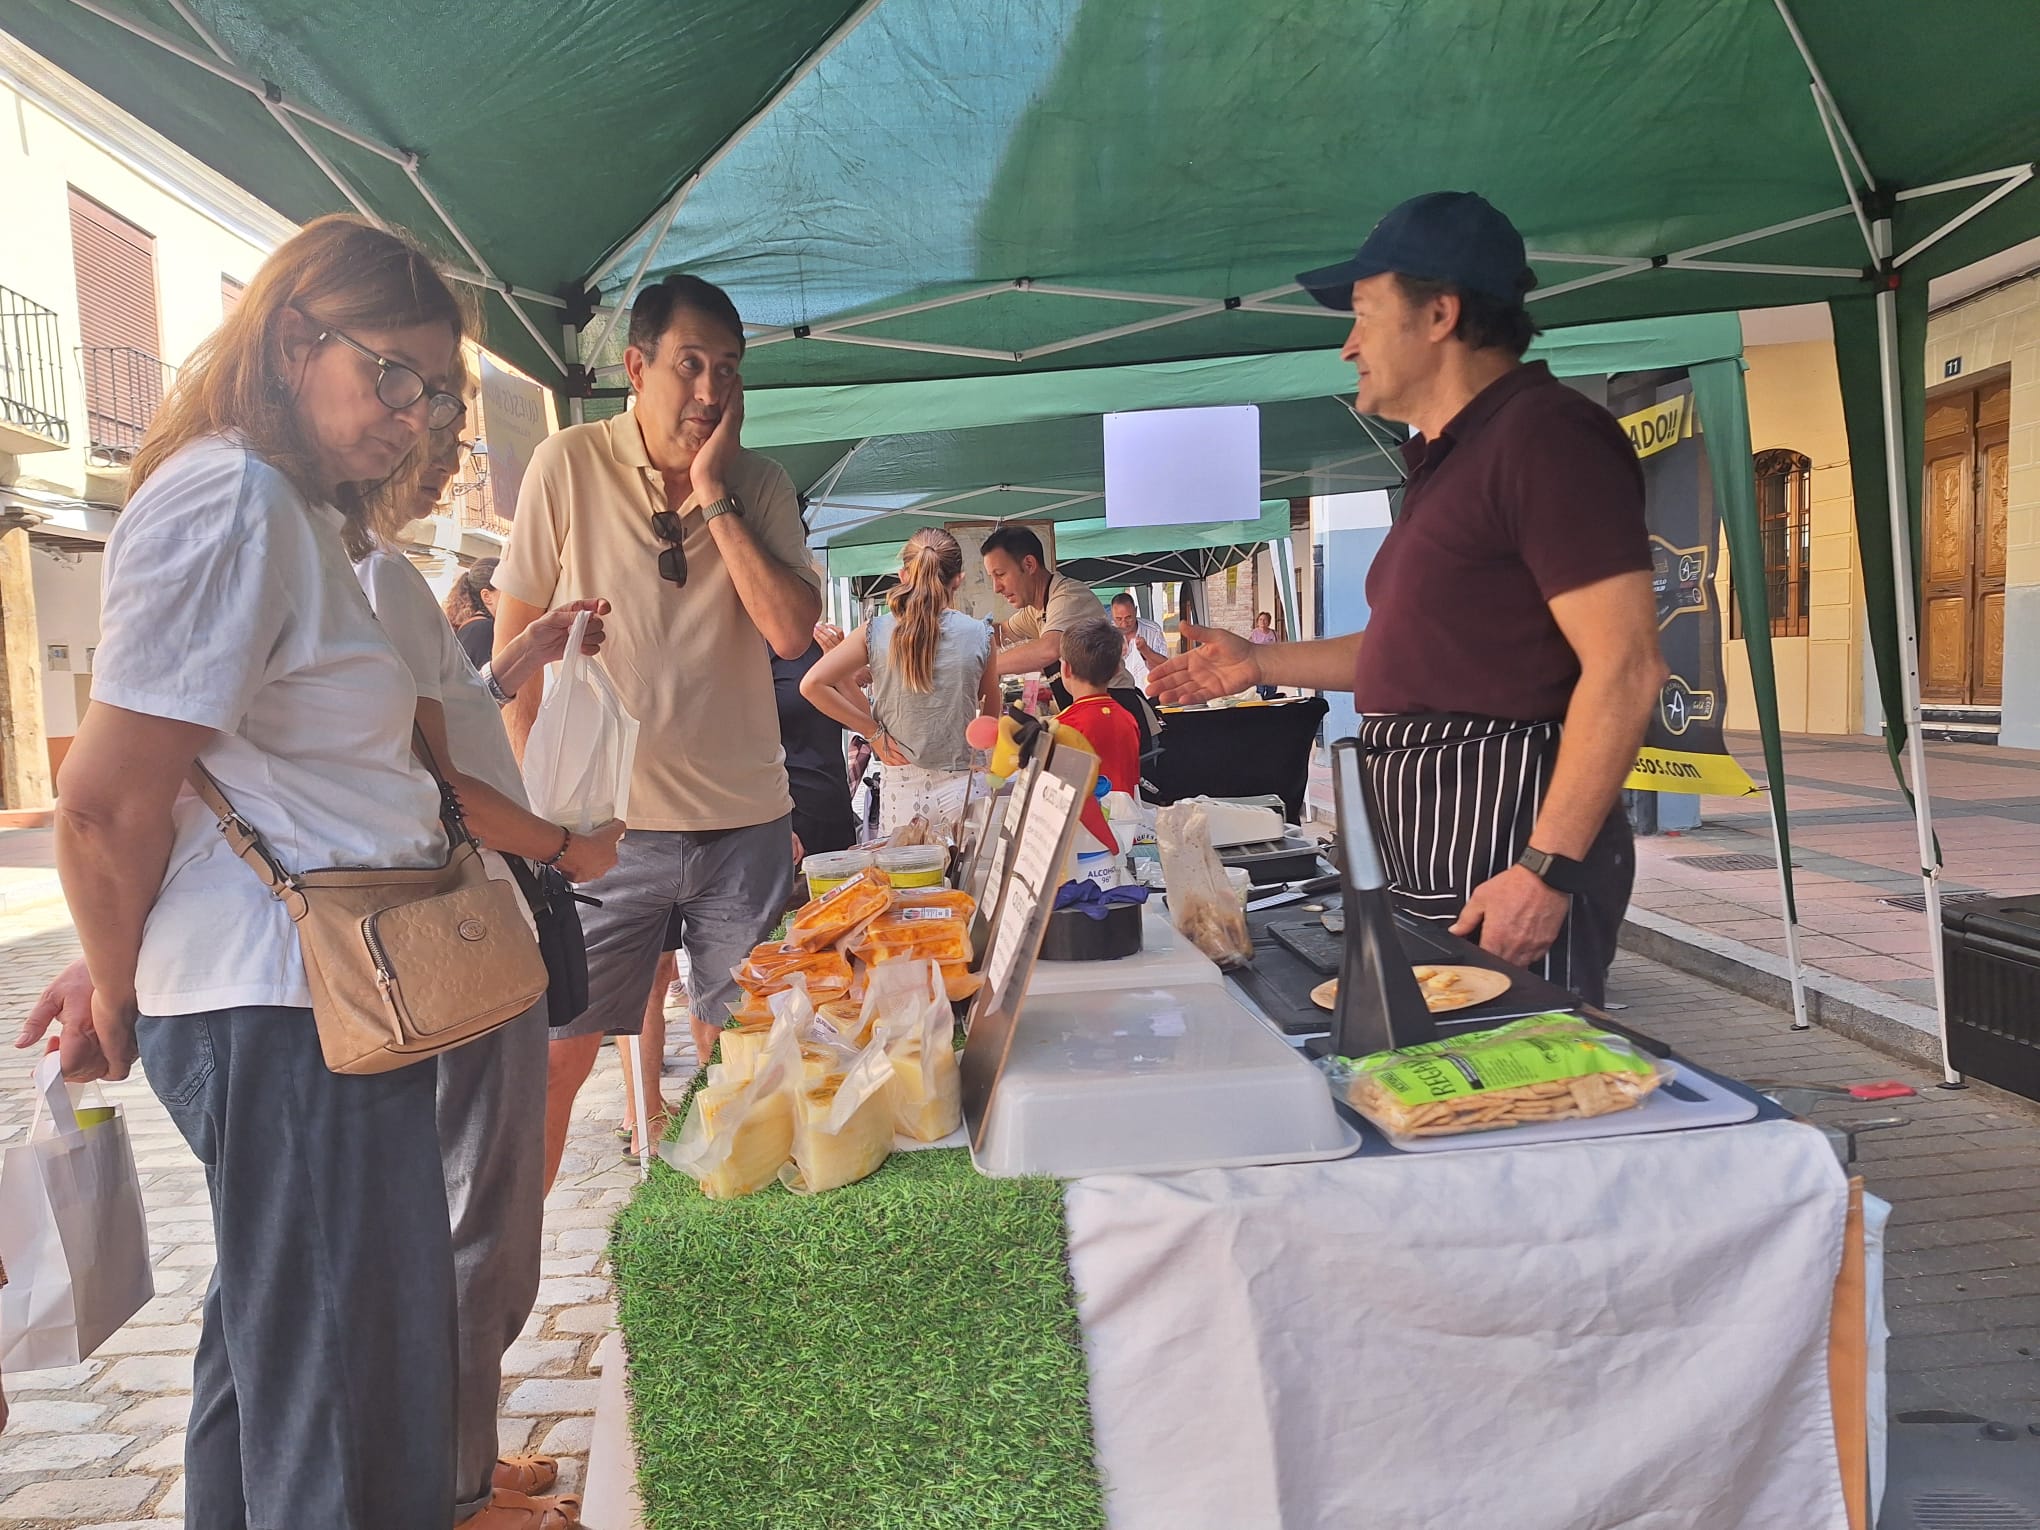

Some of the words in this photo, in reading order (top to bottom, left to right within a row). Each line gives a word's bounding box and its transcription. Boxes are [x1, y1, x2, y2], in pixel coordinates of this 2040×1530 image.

[1947, 360, 1958, 375] 11
[1630, 409, 1678, 451] ADO!!
[1633, 757, 1702, 779] esos.com
